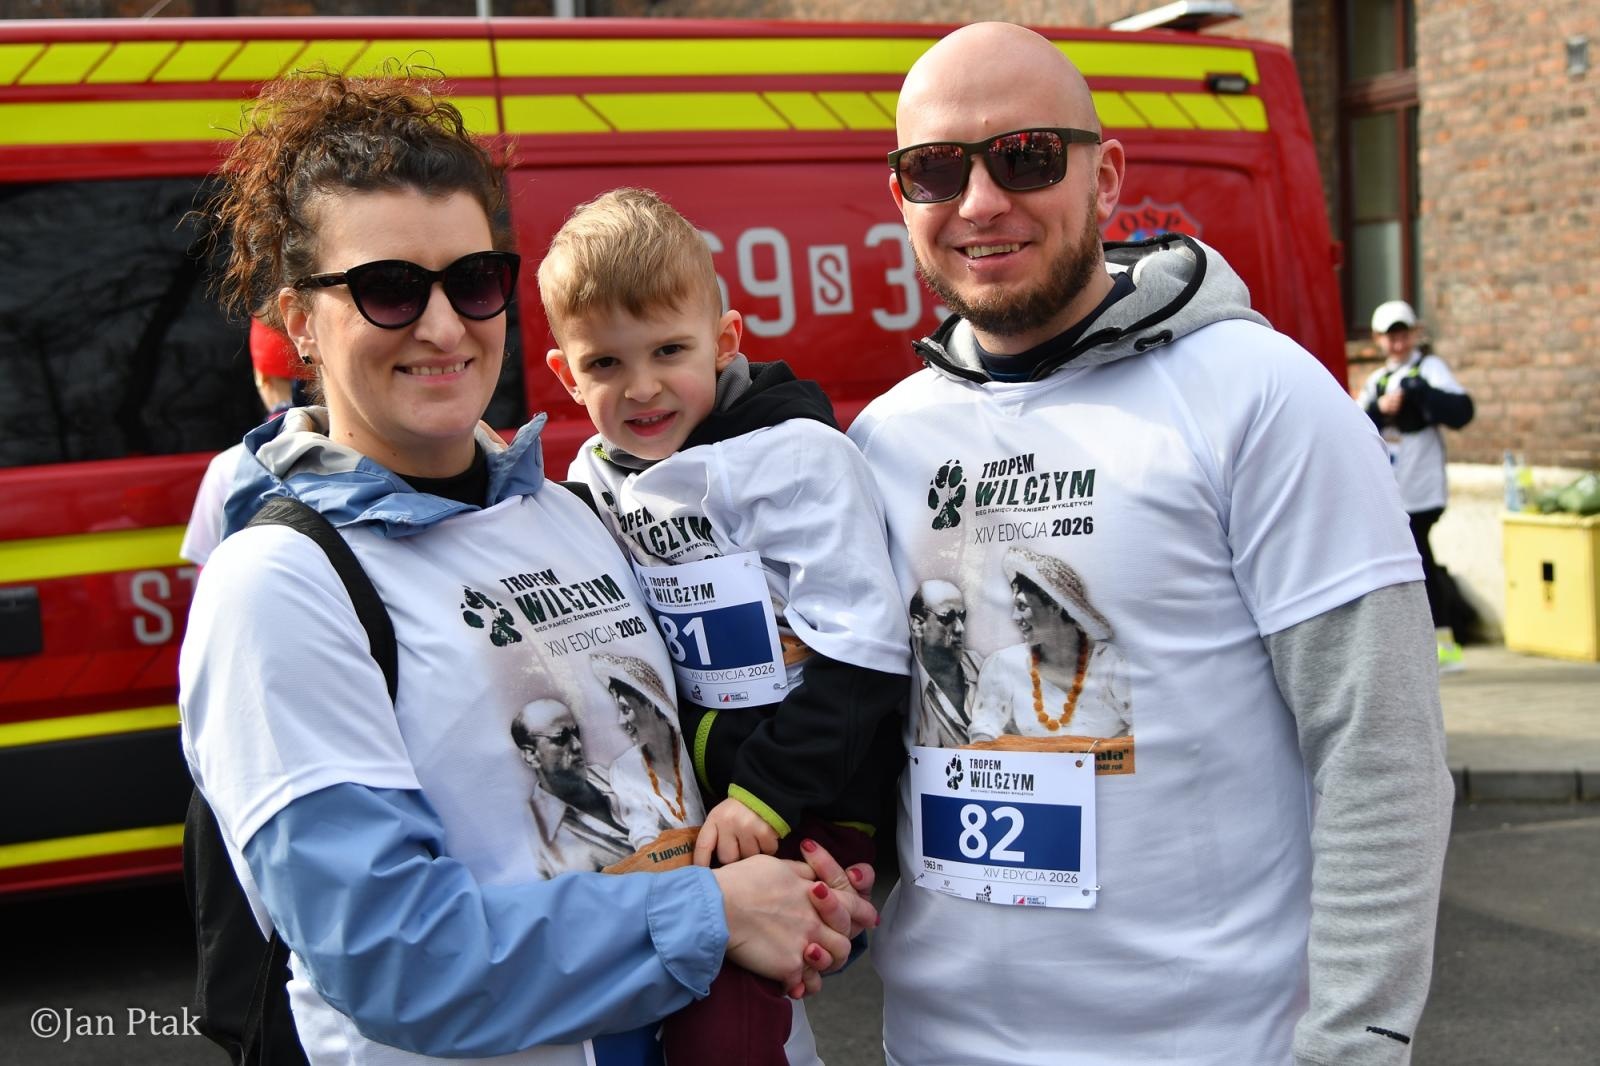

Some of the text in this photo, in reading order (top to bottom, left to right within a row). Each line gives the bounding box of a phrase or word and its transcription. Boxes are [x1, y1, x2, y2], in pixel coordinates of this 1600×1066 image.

[1119, 205, 1181, 232] OSP
[981, 453, 1035, 479] TROPEM
[974, 468, 1096, 508] WILCZYM
[1051, 500, 1093, 510] WYKLĘTYCH
[974, 516, 1094, 545] XIV EDYCJA 2026
[500, 568, 561, 594] TROPEM
[649, 576, 679, 588] TROPEM
[653, 582, 715, 604] WILCZYM
[514, 573, 626, 626] WILCZYM
[544, 615, 648, 658] XIV EDYCJA 2026
[658, 615, 712, 666] 81
[690, 663, 776, 682] XIV EDYCJA 2026
[969, 758, 1002, 771] TROPEM
[970, 770, 1034, 792] WILCZYM
[958, 803, 1025, 863] 82
[923, 859, 944, 872] 1963 m
[983, 866, 1078, 884] XIV EDYCJA 2026
